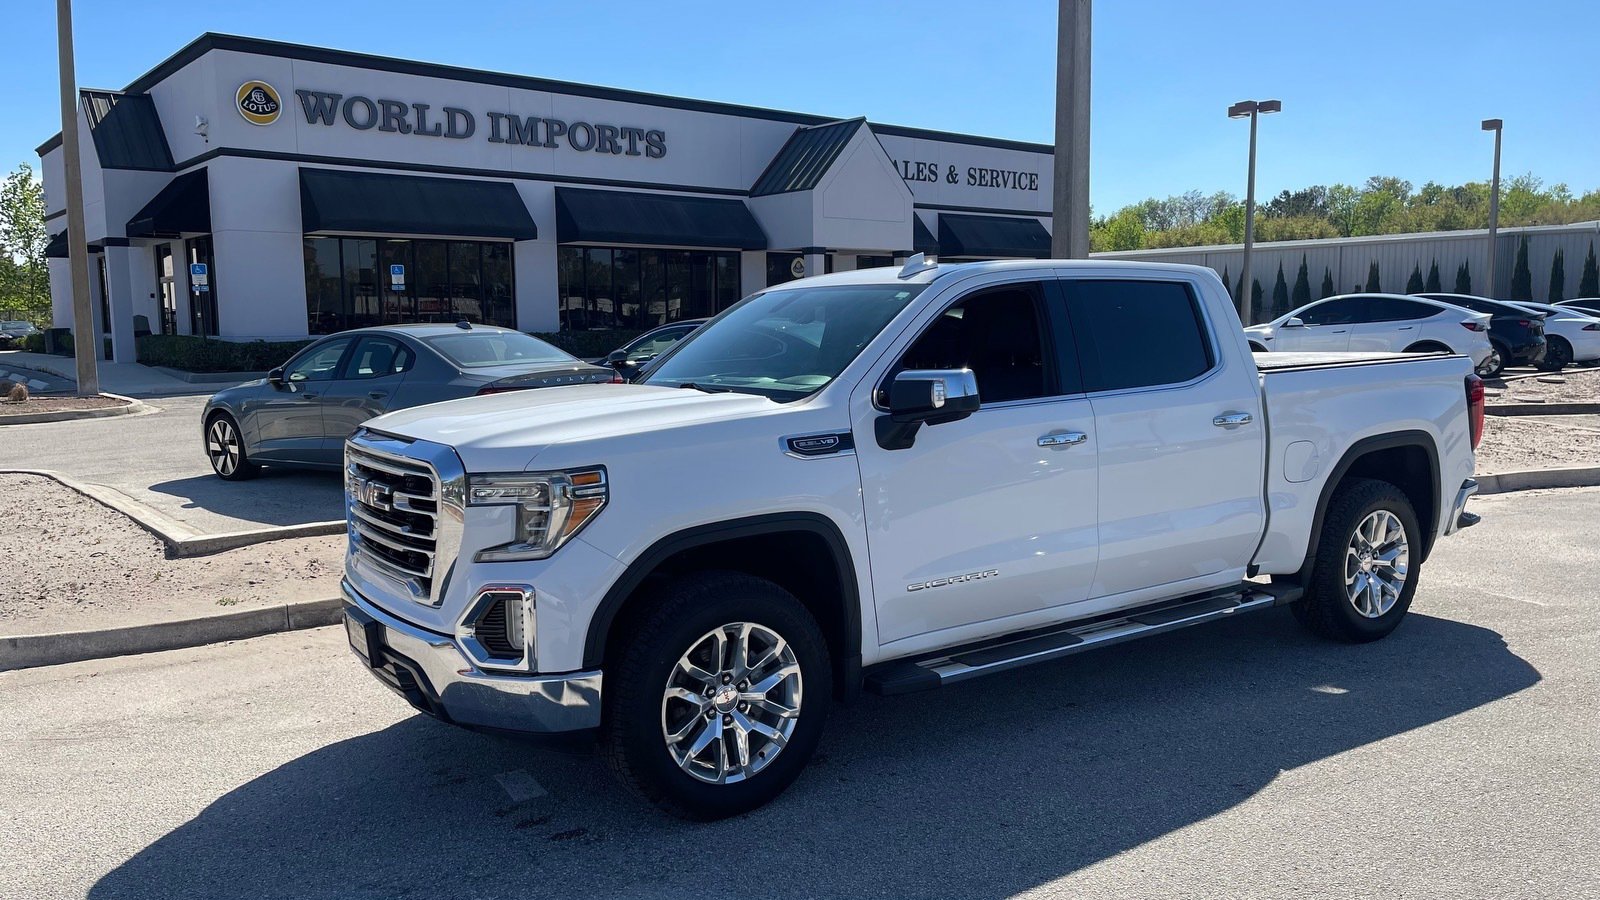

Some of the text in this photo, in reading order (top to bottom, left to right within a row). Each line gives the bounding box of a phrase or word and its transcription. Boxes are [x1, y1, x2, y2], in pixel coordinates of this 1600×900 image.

[243, 100, 276, 112] LOTUS
[295, 89, 667, 159] WORLD IMPORTS
[946, 164, 959, 185] &
[967, 167, 1039, 191] SERVICE
[542, 375, 596, 384] VOLVO
[906, 569, 998, 592] SIERRA
